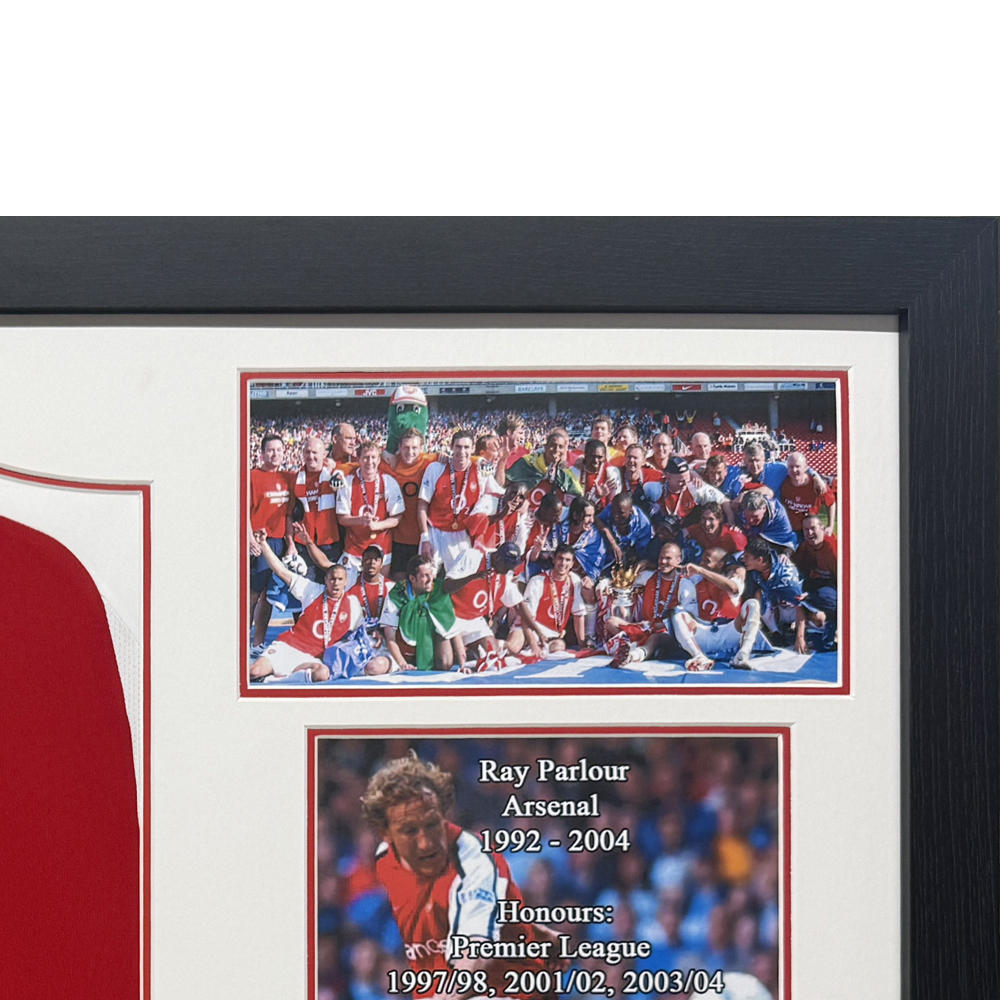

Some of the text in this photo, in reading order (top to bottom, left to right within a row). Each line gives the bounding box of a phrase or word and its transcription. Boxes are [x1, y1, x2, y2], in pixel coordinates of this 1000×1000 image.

[479, 758, 630, 786] Ray Parlour
[501, 793, 599, 817] Arsenal
[482, 830, 541, 852] 1992
[568, 829, 630, 851] 2004
[497, 901, 612, 923] Honours:
[451, 936, 650, 964] Premier League
[388, 970, 724, 997] 1997/98, 2001/02, 2003/04
